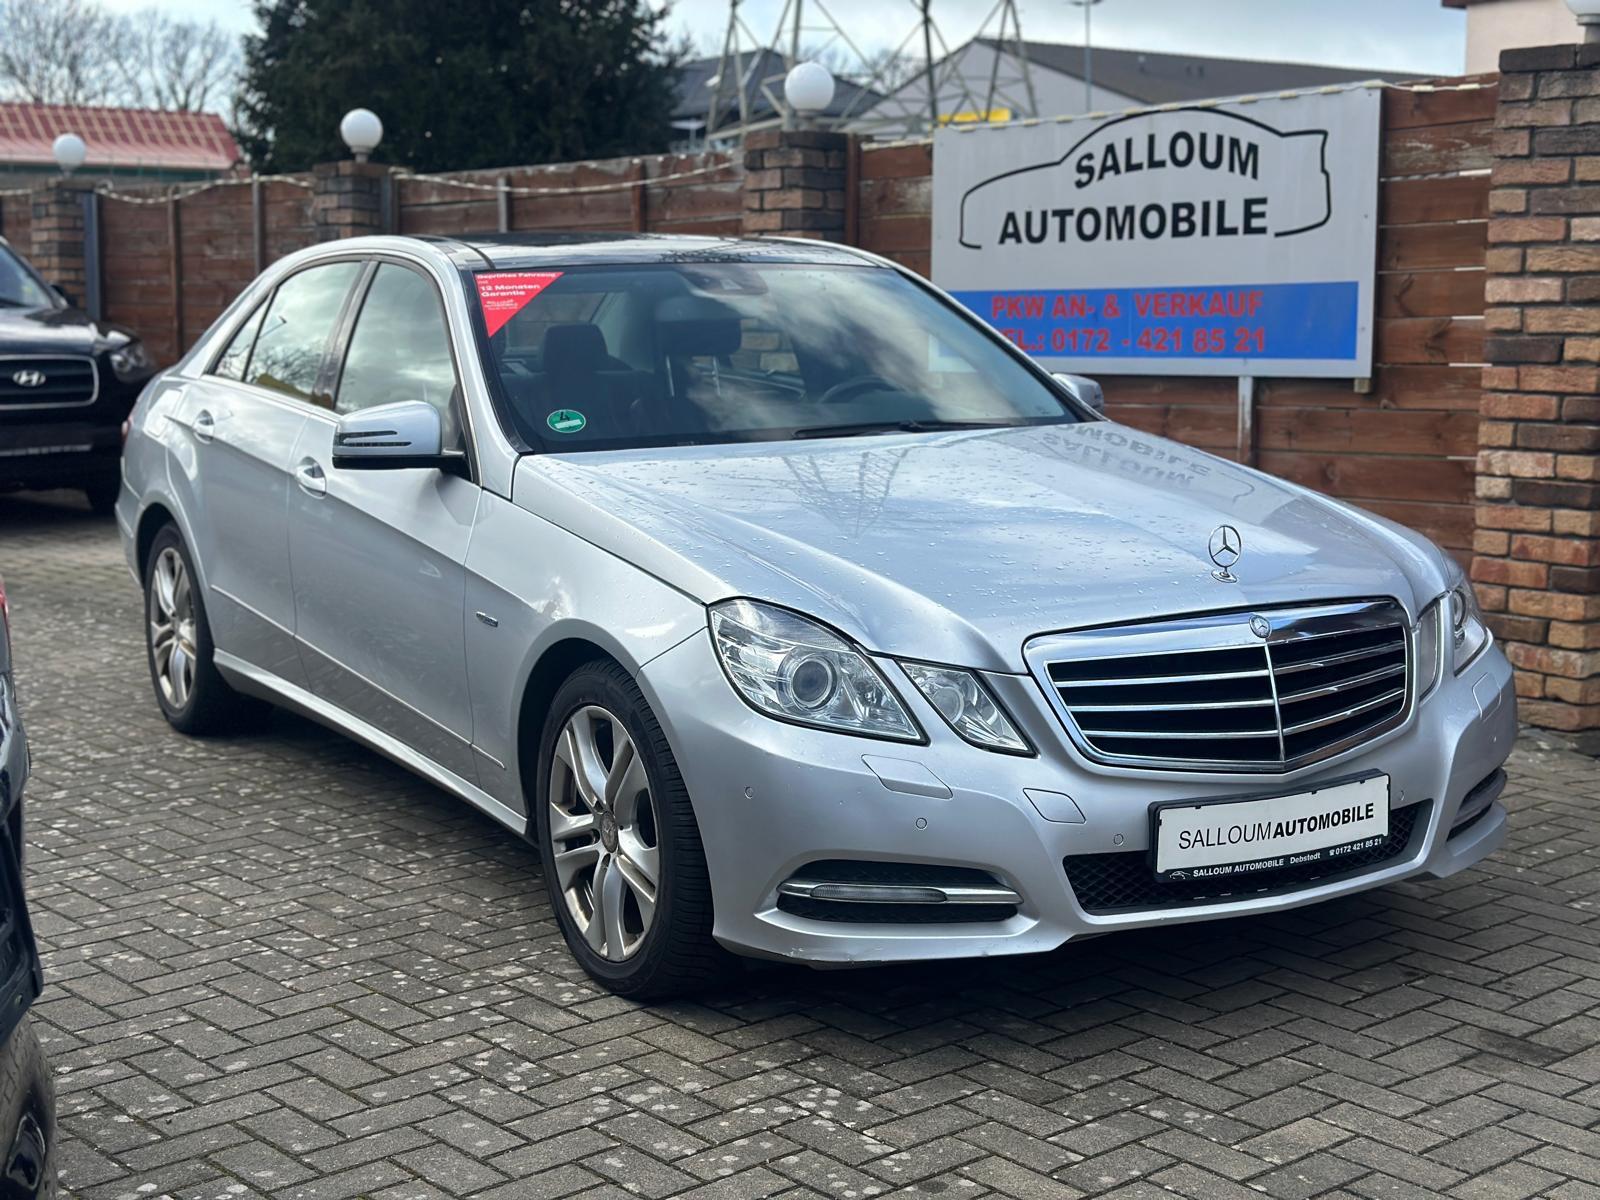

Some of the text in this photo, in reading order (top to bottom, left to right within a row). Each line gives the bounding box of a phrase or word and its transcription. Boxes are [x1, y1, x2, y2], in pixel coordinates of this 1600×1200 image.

[1075, 131, 1258, 188] SALLOUM
[998, 197, 1268, 244] AUTOMOBILE
[992, 295, 1044, 319] PKW
[1103, 294, 1120, 318] &
[1134, 290, 1263, 318] VERKAUF
[1052, 328, 1110, 352] 0172
[1137, 328, 1182, 351] 421
[1192, 328, 1225, 352] 85
[1234, 327, 1264, 352] 21
[1193, 866, 1232, 877] SALLOUM
[1234, 859, 1284, 873] AUTOMOBILE
[1290, 852, 1320, 864] Debstedt
[1353, 842, 1364, 851] 421
